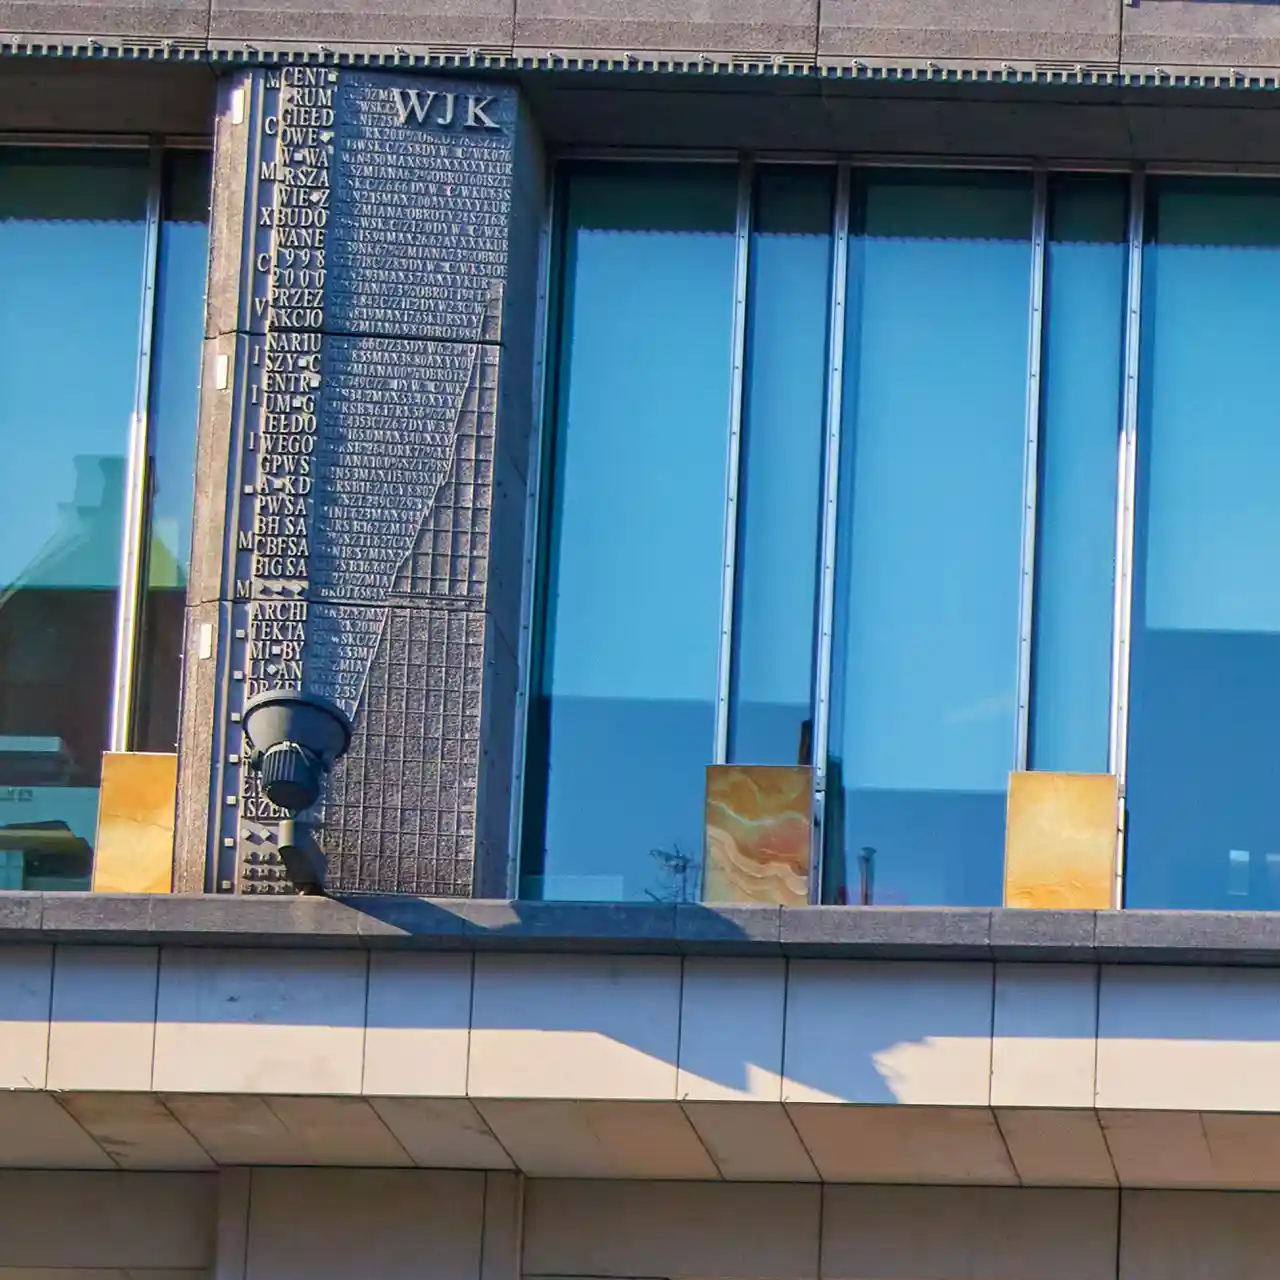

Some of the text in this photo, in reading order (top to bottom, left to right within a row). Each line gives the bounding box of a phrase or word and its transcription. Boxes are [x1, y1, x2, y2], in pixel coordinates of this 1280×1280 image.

[282, 67, 328, 86] CENT
[294, 88, 332, 106] RUM
[281, 108, 334, 126] GIEŁD
[390, 88, 500, 128] WJK
[280, 127, 318, 146] OWE
[285, 168, 329, 187] RSZA
[276, 208, 327, 228] BUDO
[276, 228, 325, 247] WANE
[275, 248, 325, 268] 998
[271, 288, 324, 307] PRZEZ
[270, 308, 323, 328] AKCJO
[268, 333, 321, 351] NARIU
[266, 353, 296, 372] SZY
[266, 374, 309, 392] ENTR
[263, 434, 313, 453] WEGO
[252, 602, 308, 621] ARCHI
[250, 621, 305, 640] TEKTA
